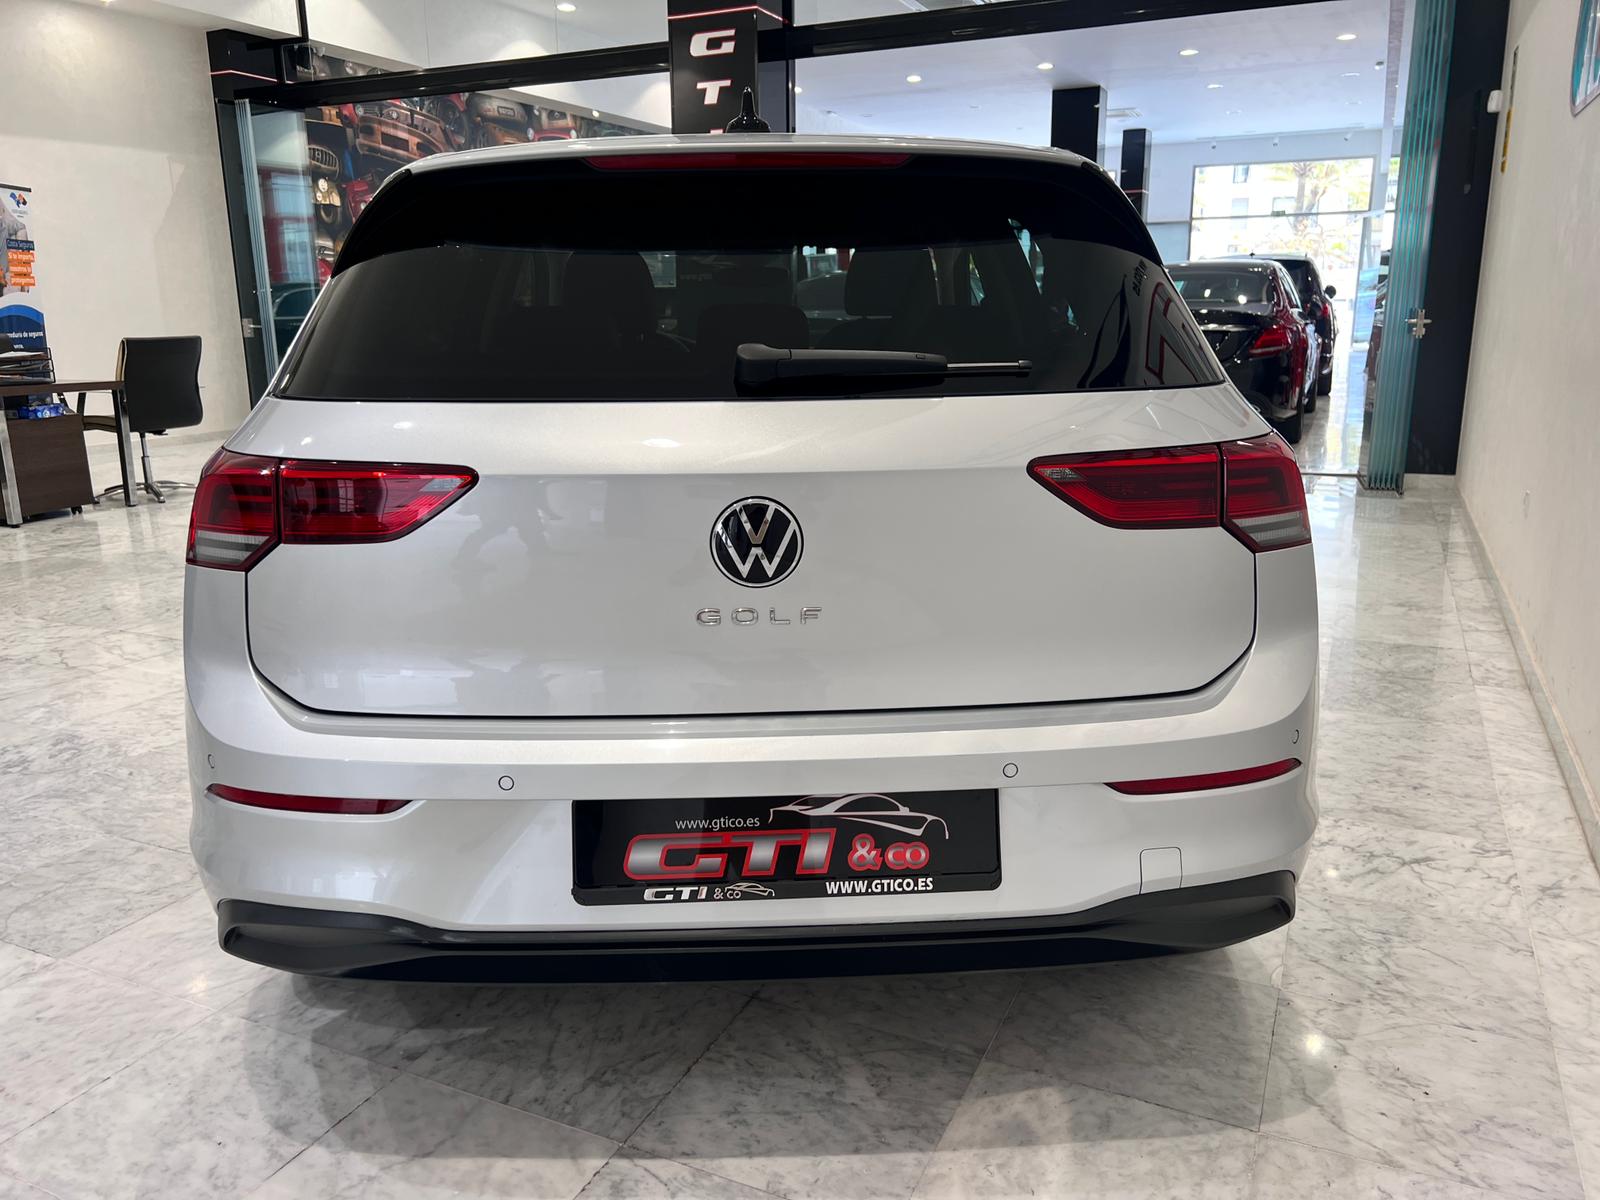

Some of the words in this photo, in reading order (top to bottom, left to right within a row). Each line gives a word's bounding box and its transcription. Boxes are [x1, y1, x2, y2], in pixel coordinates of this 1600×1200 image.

[689, 28, 737, 135] GT
[696, 607, 822, 626] GOLF
[675, 816, 760, 831] www.gtico.es
[623, 828, 836, 880] GTI
[643, 886, 708, 901] GTI
[825, 878, 934, 895] WWW.GTICO.ES
